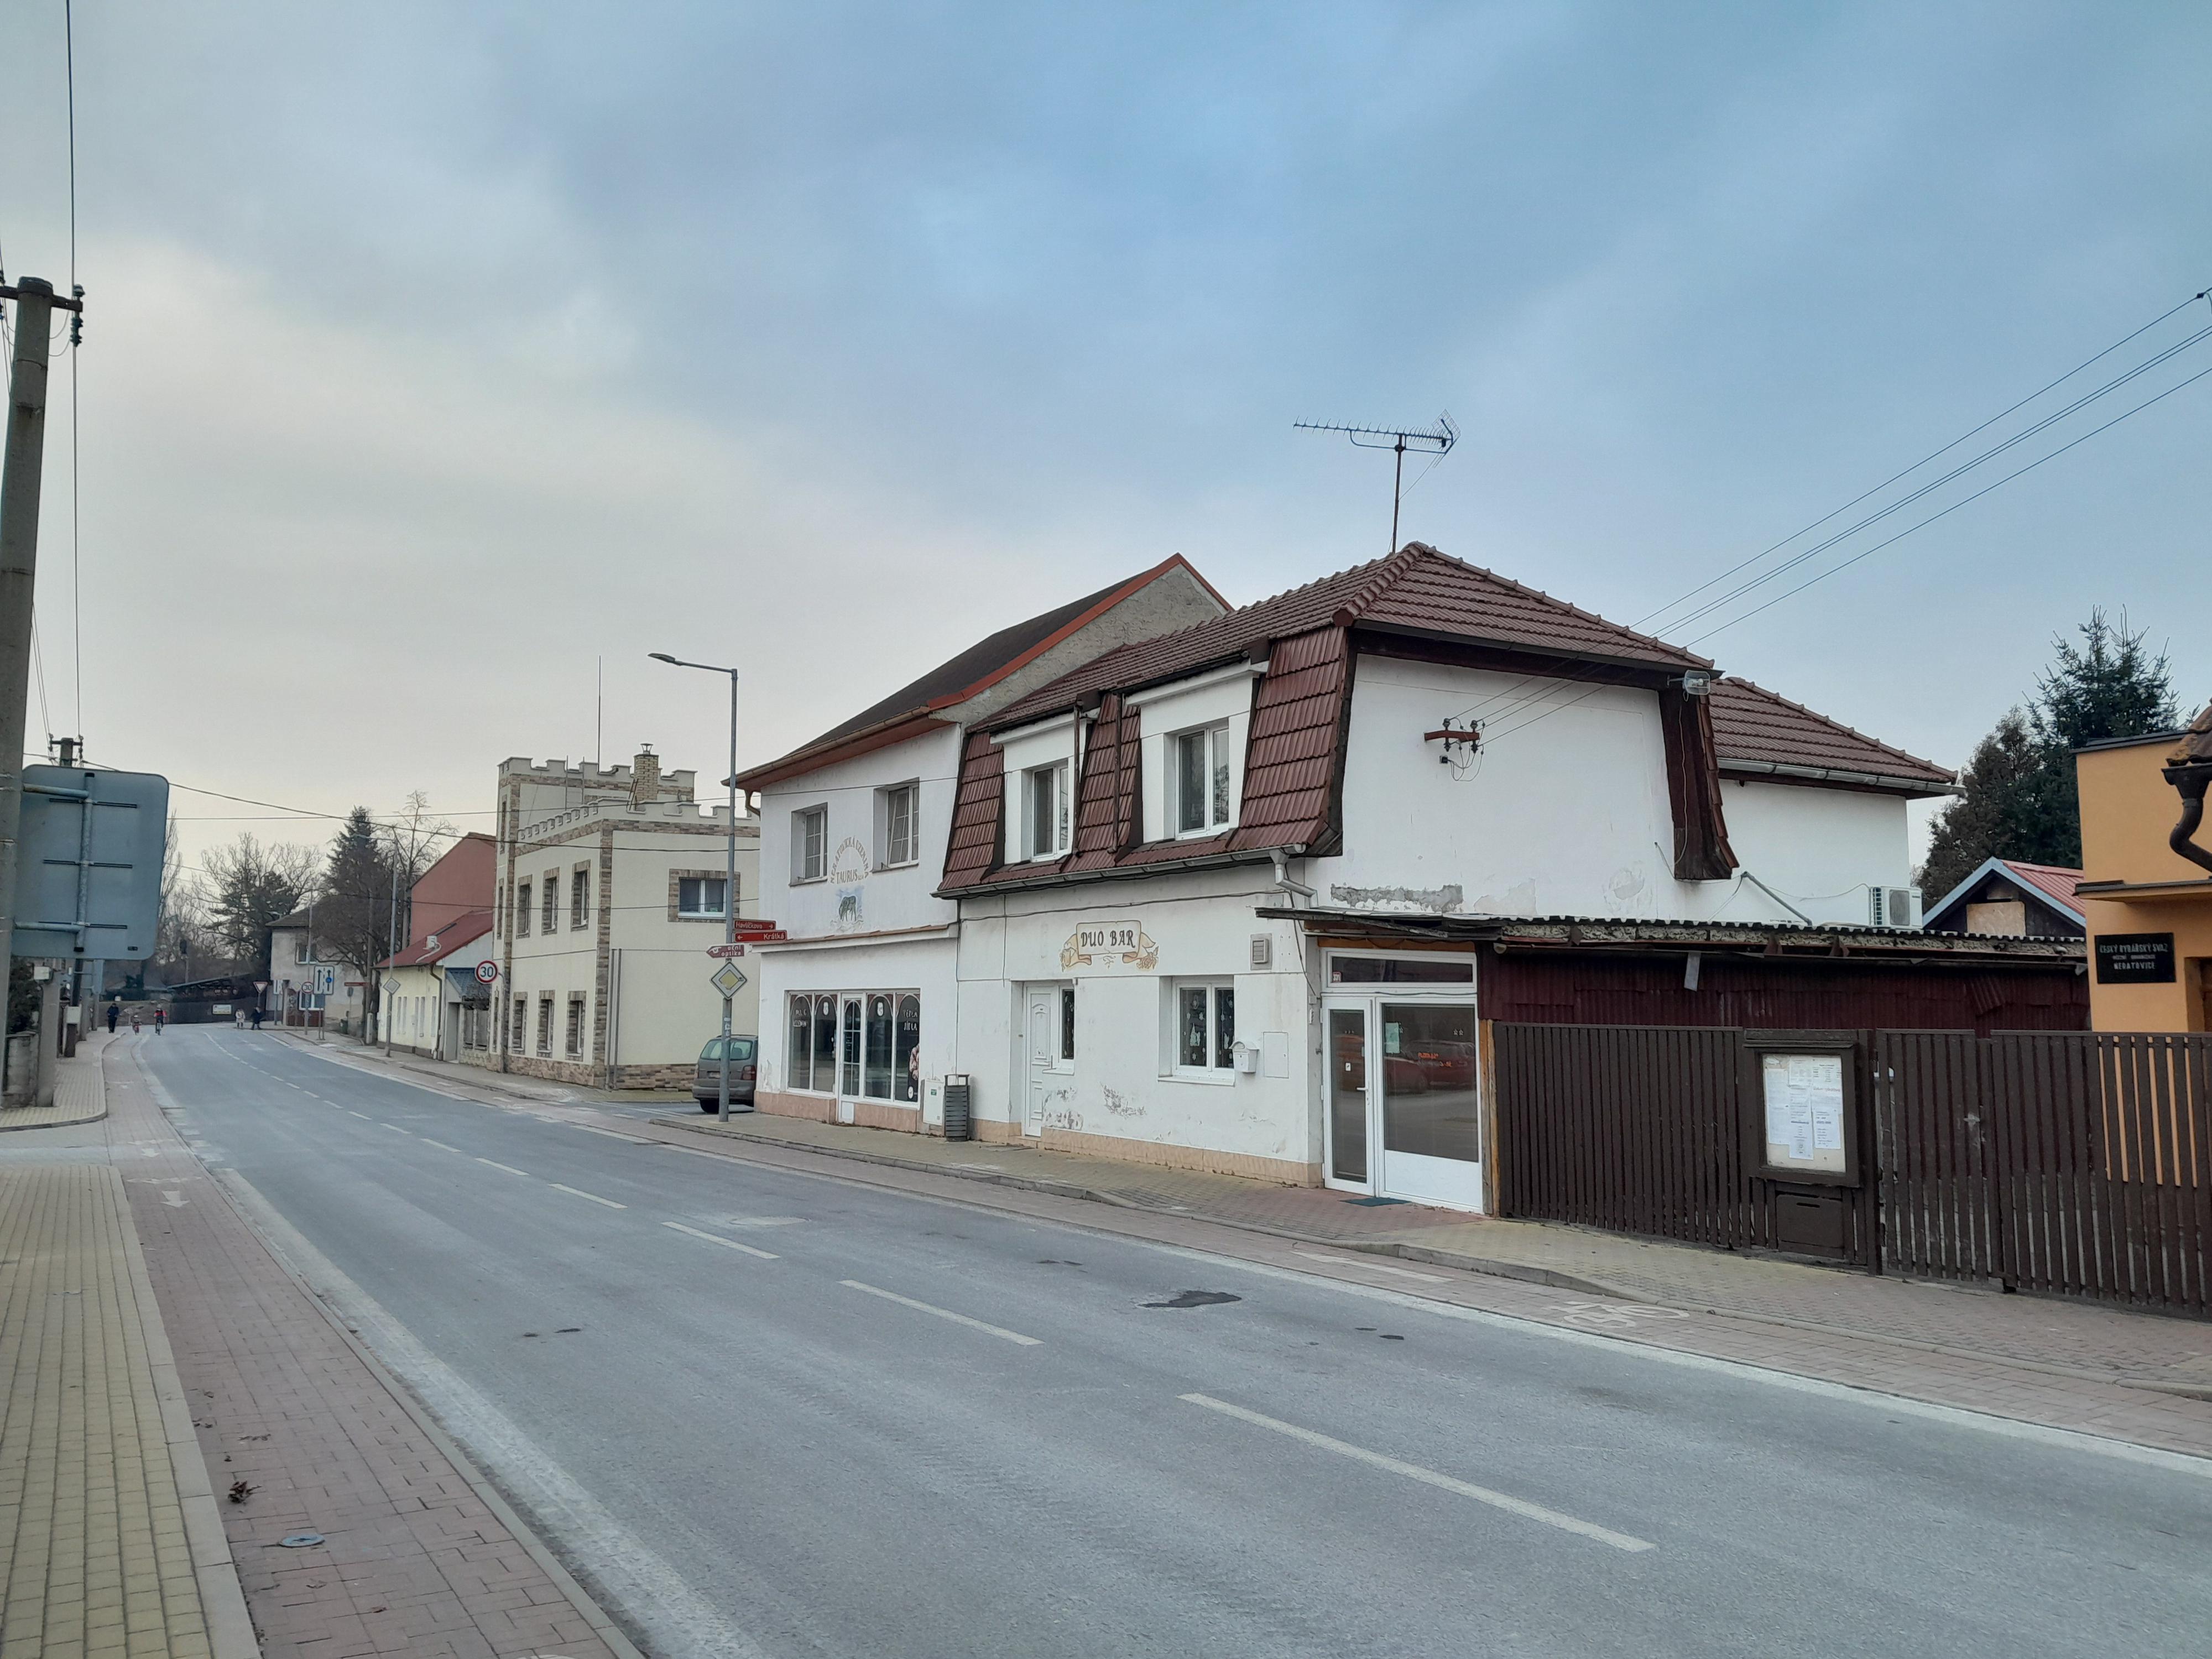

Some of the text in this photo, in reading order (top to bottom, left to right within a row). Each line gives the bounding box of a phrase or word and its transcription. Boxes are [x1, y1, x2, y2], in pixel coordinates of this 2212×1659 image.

[836, 869, 858, 884] TAURUS
[1081, 929, 1136, 948] DUO BAR
[480, 966, 493, 977] 30
